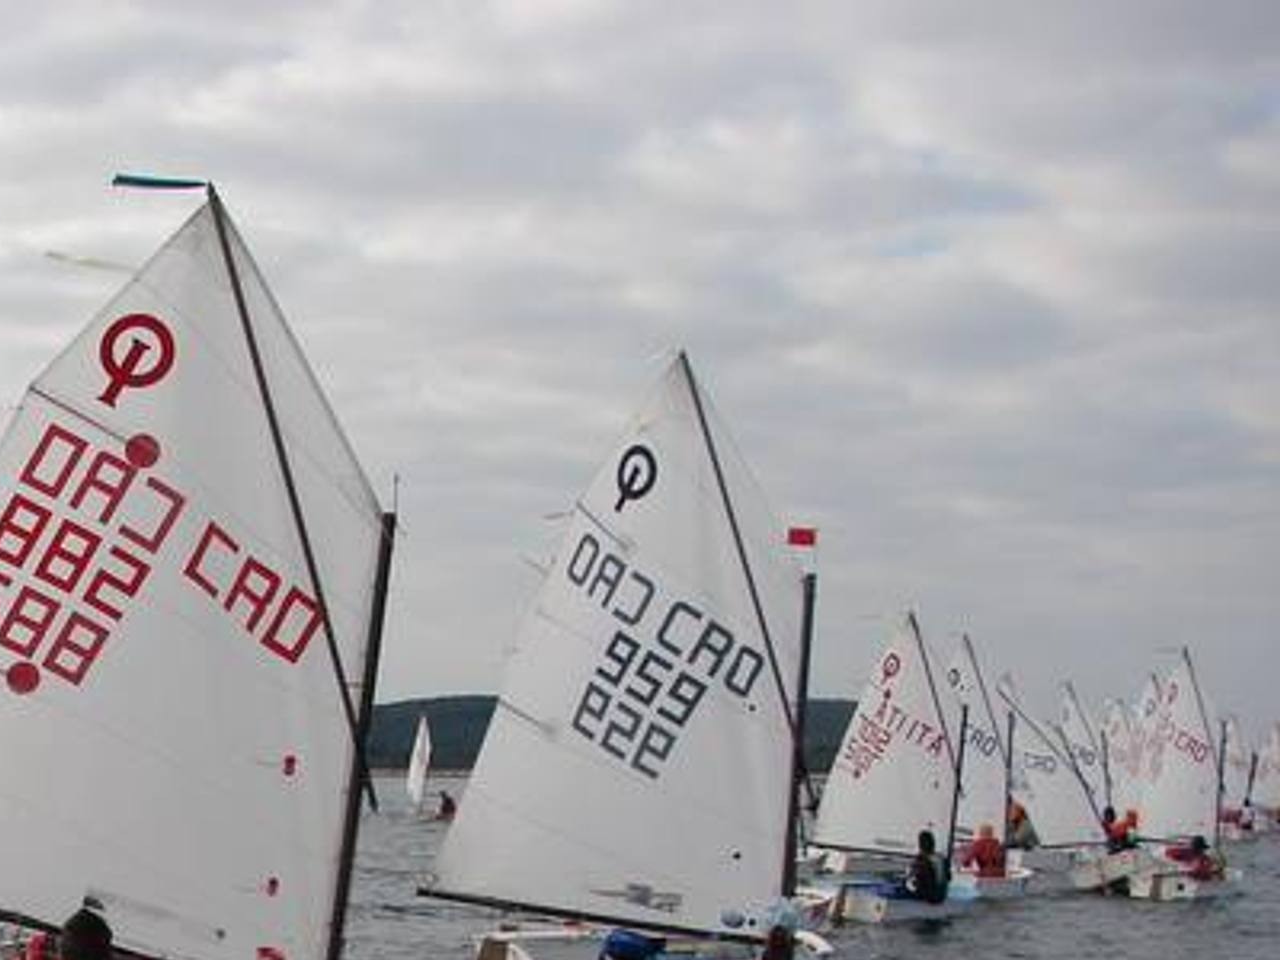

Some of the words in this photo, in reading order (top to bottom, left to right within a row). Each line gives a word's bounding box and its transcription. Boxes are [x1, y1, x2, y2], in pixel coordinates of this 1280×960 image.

[182, 521, 324, 664] CRO
[595, 630, 708, 728] 959
[657, 601, 764, 698] CRO
[906, 720, 943, 755] ITA
